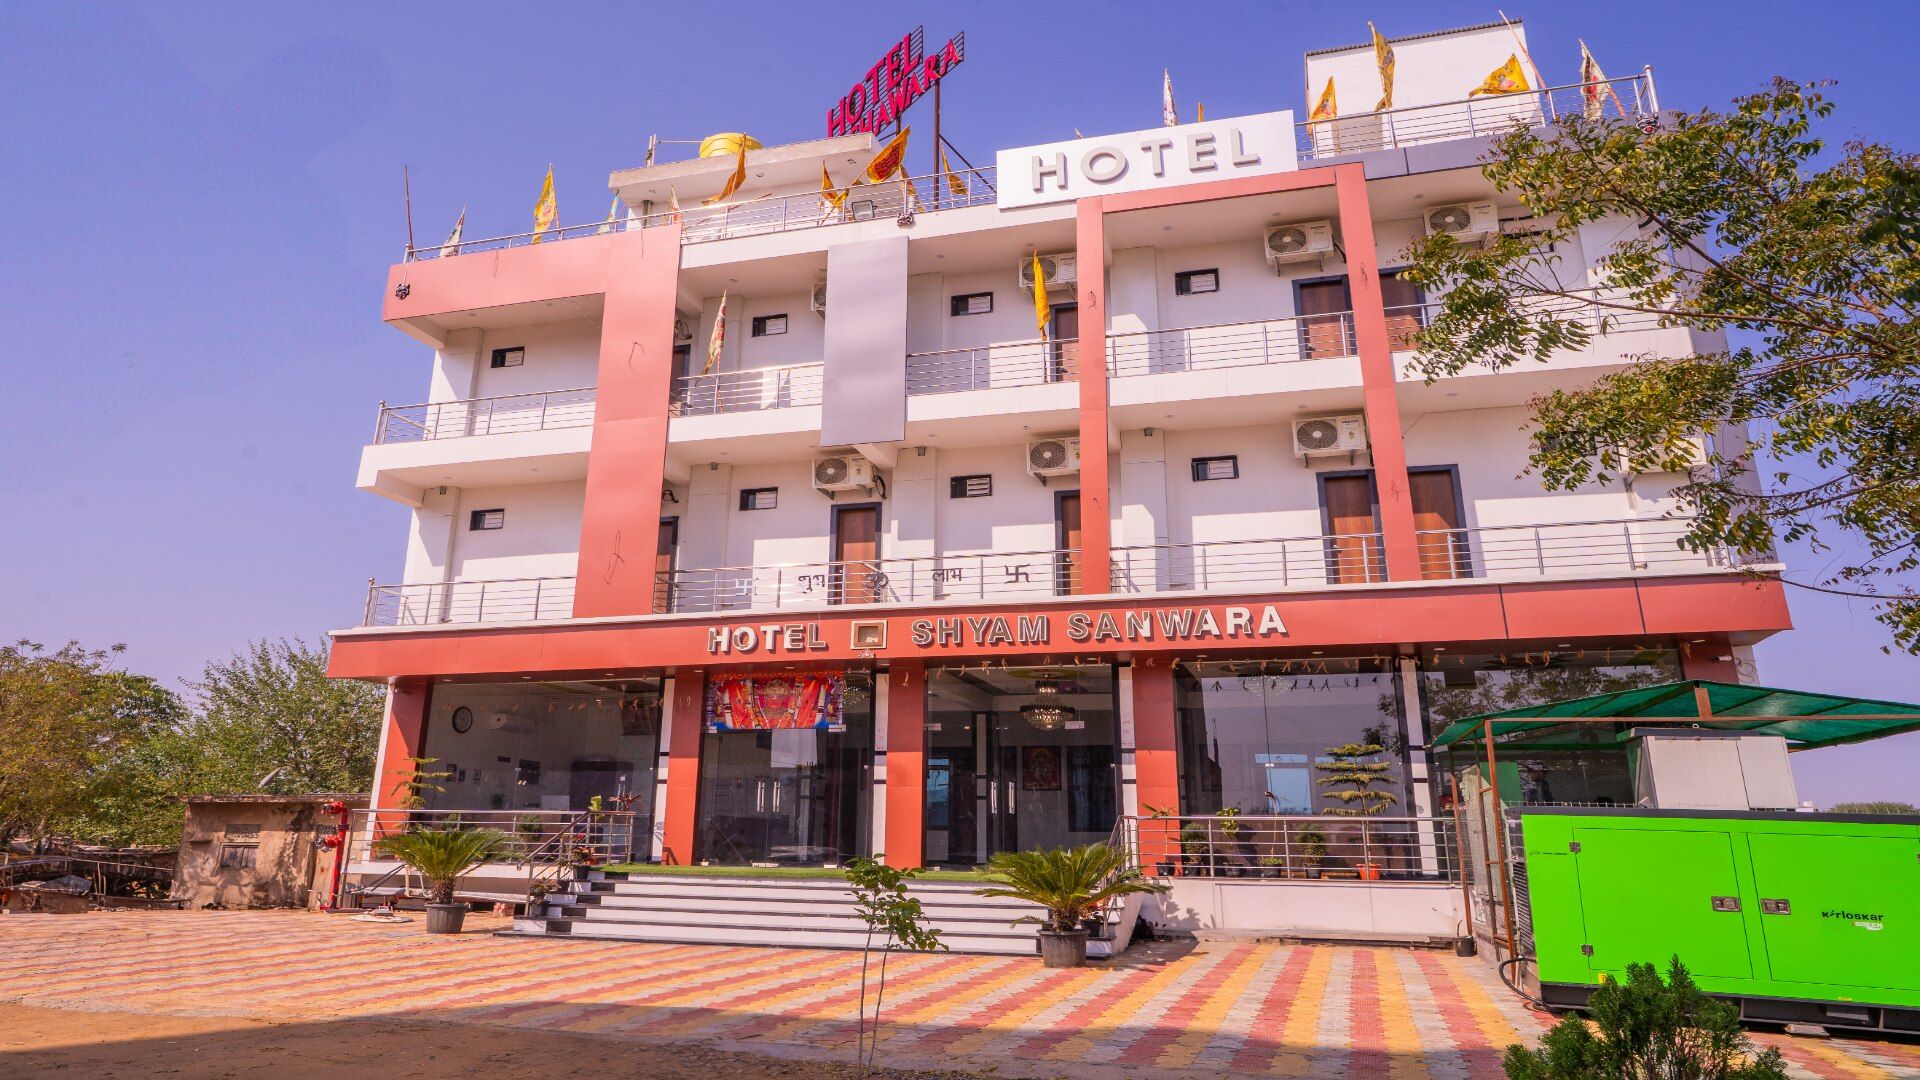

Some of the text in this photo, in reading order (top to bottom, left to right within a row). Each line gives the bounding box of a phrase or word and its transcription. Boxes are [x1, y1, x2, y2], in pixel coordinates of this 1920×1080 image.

[827, 32, 922, 138] HOTEL
[1031, 128, 1262, 192] HOTEL
[931, 567, 963, 582] लाभ
[707, 605, 1288, 654] HOTEL SHYAM SANWARA
